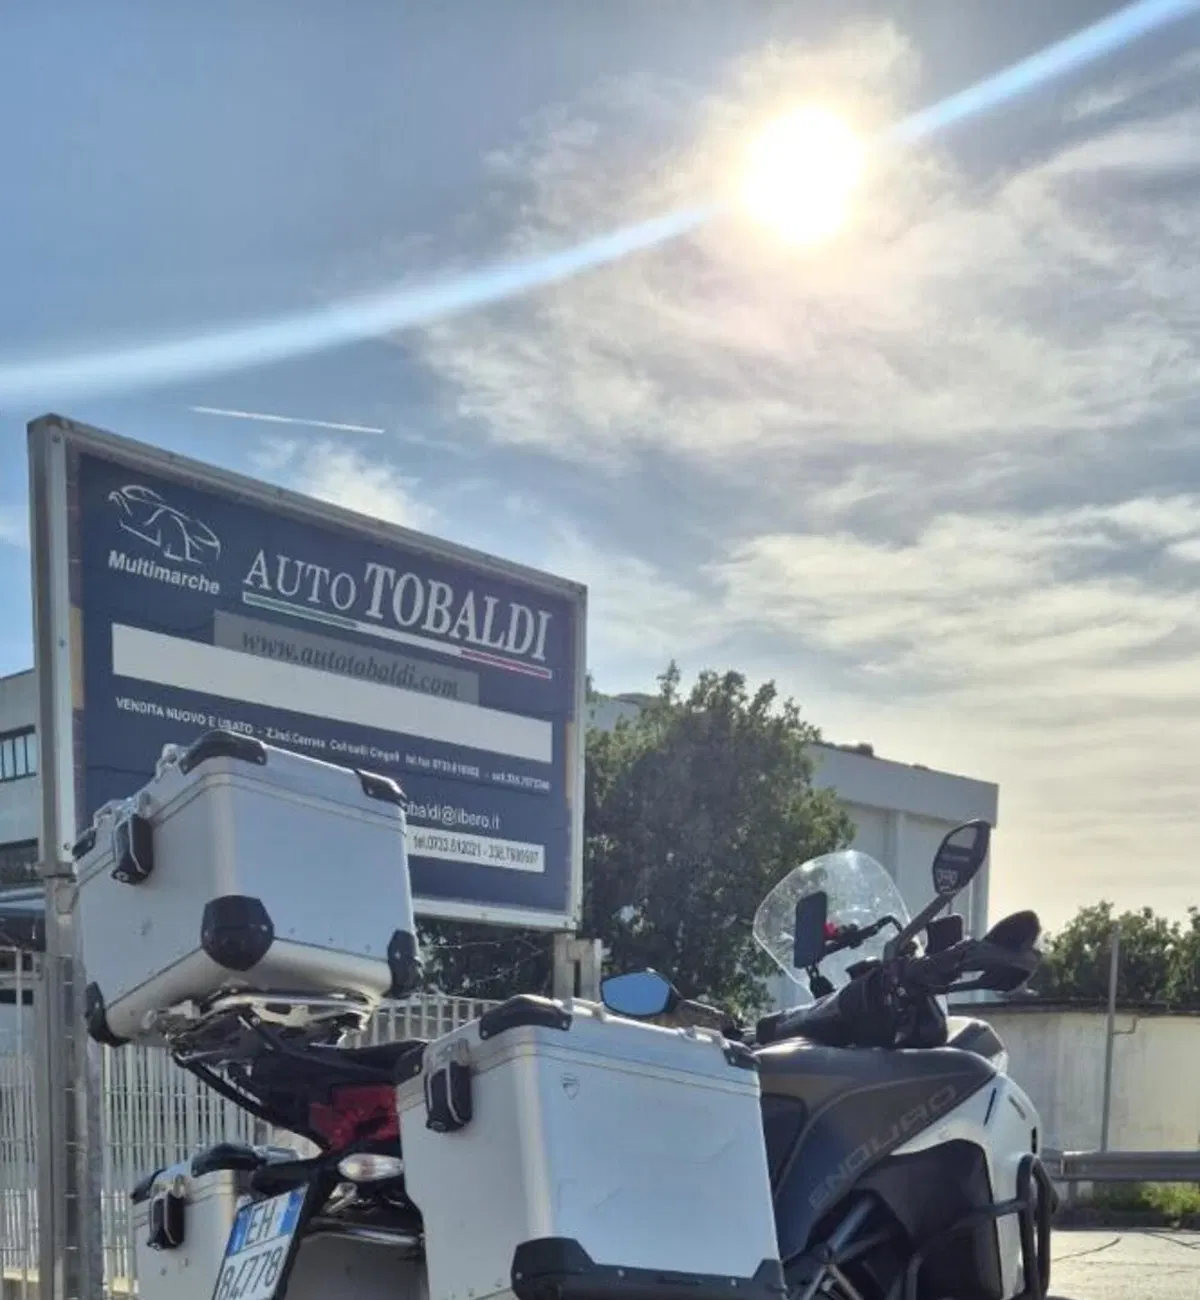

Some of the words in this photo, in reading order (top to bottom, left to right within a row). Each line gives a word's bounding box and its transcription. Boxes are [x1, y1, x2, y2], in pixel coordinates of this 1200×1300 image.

[108, 549, 221, 596] Multimarche
[242, 549, 357, 611] AUTO
[363, 562, 553, 663] TOBALDI
[242, 629, 460, 700] www.autotobaldi.com
[115, 696, 165, 718] VENDITA
[165, 706, 207, 726] NUOVO
[208, 715, 216, 728] E
[217, 717, 254, 735] USATO
[807, 1083, 957, 1211] ENDURO
[244, 1198, 278, 1247] EH
